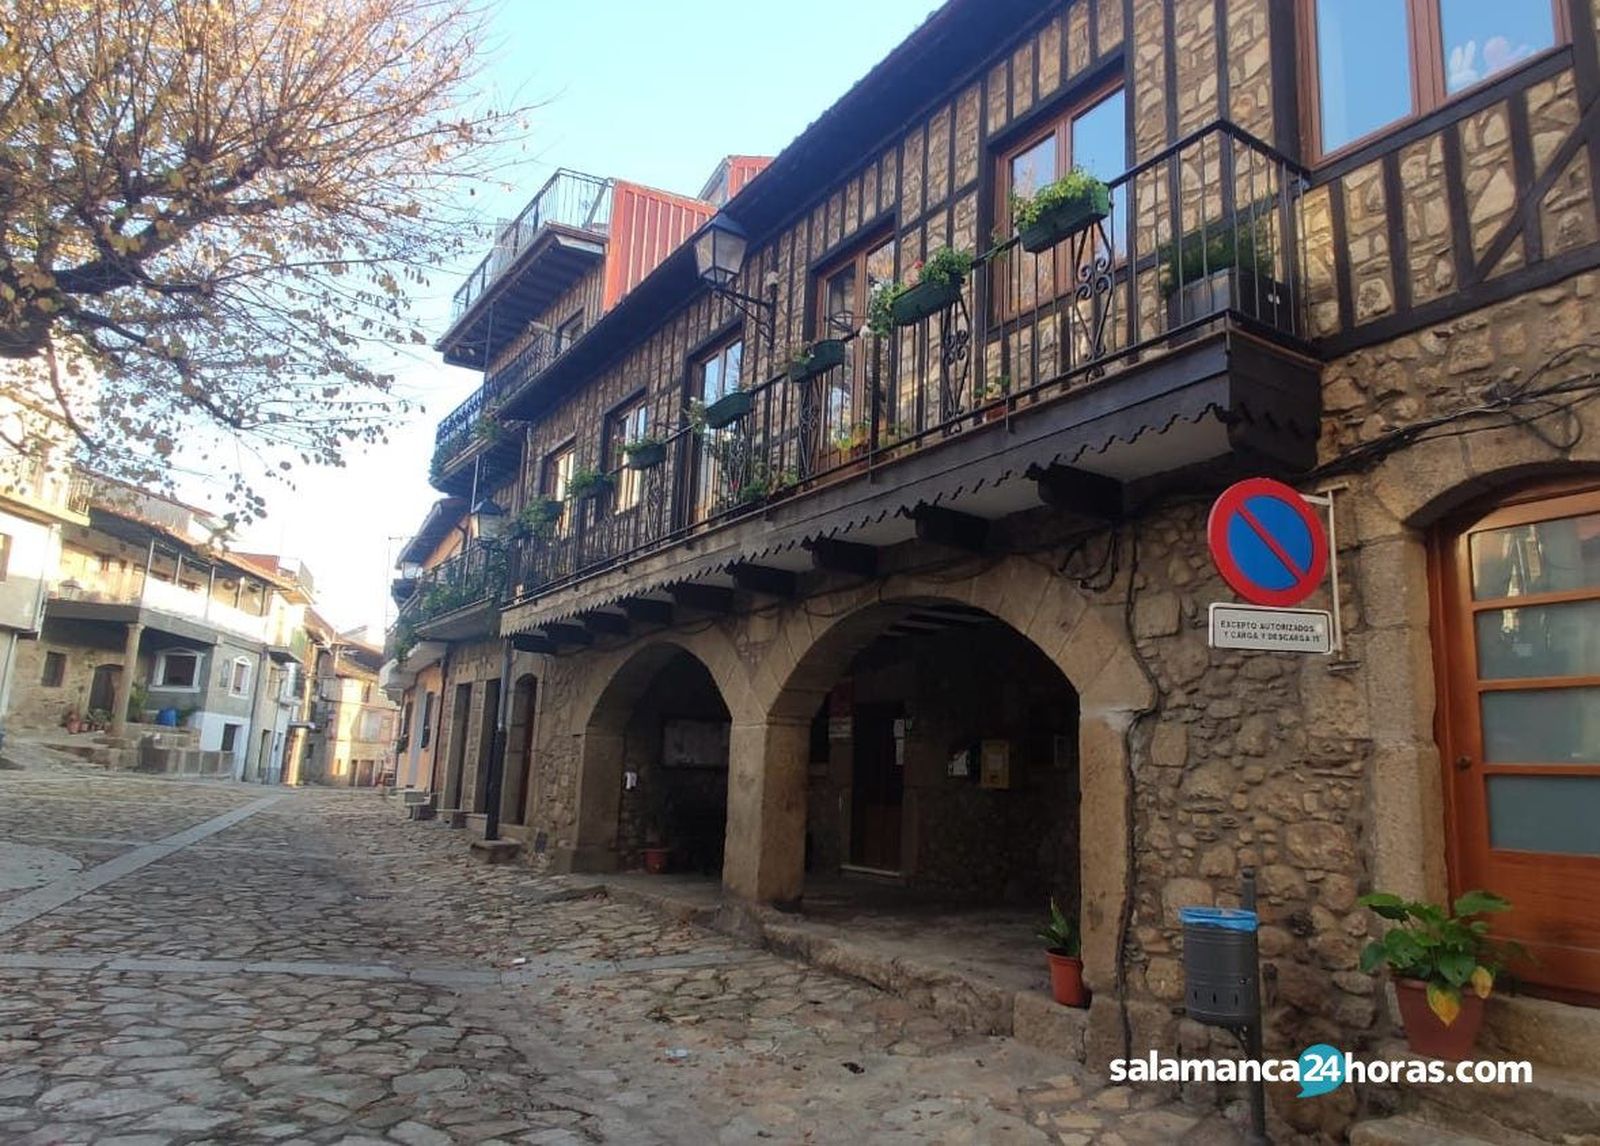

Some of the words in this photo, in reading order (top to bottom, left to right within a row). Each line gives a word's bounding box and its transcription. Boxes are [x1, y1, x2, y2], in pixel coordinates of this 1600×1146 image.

[1220, 620, 1257, 630] EXCEPTO
[1259, 622, 1315, 633] AUTORIZADOS
[1231, 632, 1259, 640] CARGA
[1268, 633, 1310, 642] DESCARGA
